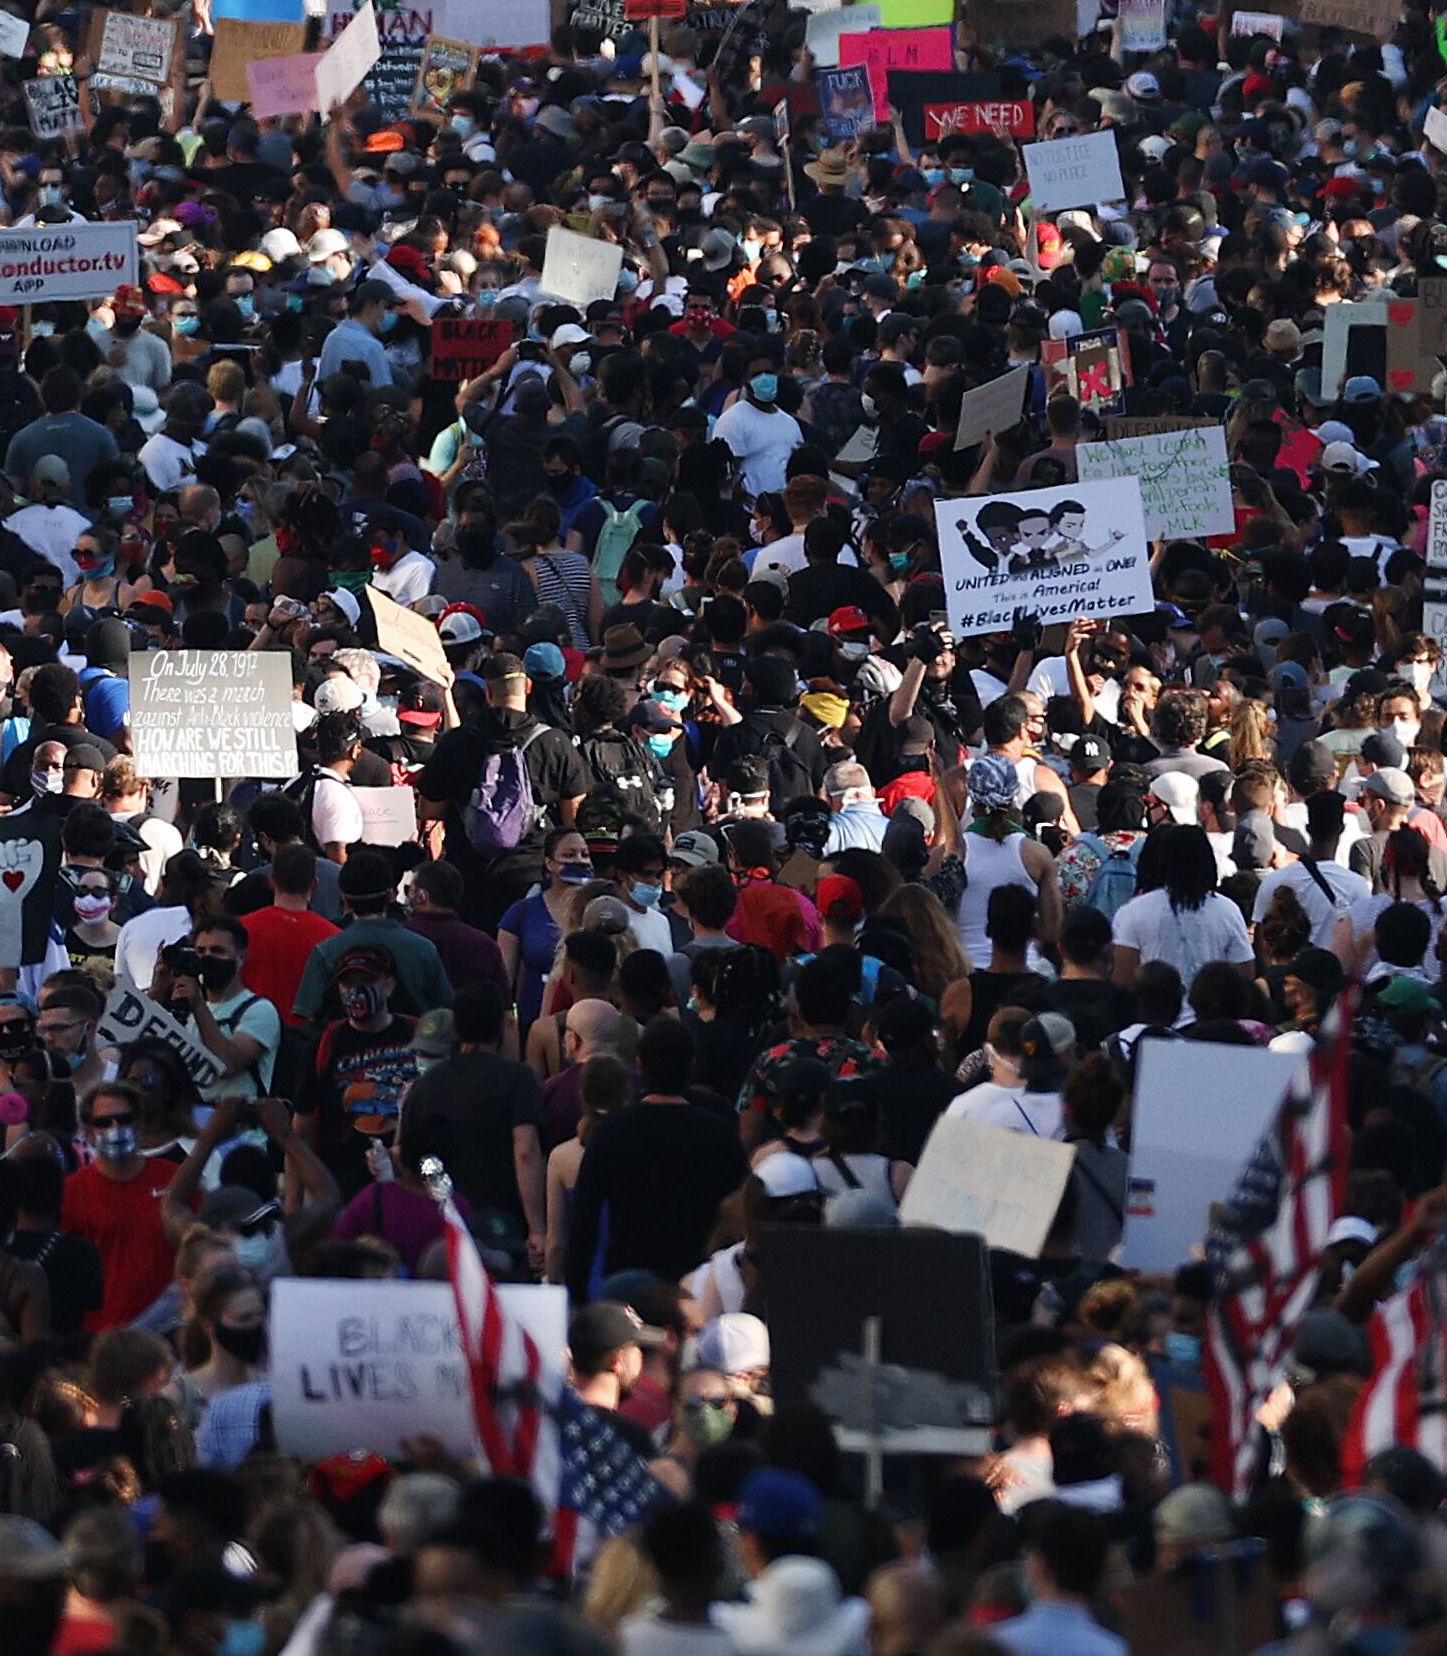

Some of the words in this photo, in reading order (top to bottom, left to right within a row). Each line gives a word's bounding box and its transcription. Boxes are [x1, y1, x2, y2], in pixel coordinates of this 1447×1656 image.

[929, 105, 970, 128] WE
[975, 102, 1025, 127] NEED
[956, 572, 1009, 591] UNITED
[1030, 562, 1090, 581] ALIGNED
[1106, 556, 1138, 573] ONE!
[1033, 578, 1101, 598] America!
[961, 594, 1136, 629] #BlackLivesMatter
[151, 650, 175, 678] On
[175, 650, 207, 686] July
[142, 677, 182, 704] There
[185, 687, 206, 704] was
[222, 680, 265, 704] march
[133, 707, 183, 728] against
[243, 706, 292, 728] violence
[138, 728, 175, 752] HOW
[178, 728, 204, 752] ARE
[206, 728, 232, 752] WE
[233, 727, 281, 752] STILL
[138, 752, 216, 777] MARCHING
[219, 752, 244, 776] FOR
[110, 990, 220, 1089] DEFUND
[337, 1314, 462, 1358] BLACK
[299, 1362, 417, 1403] LIVES
